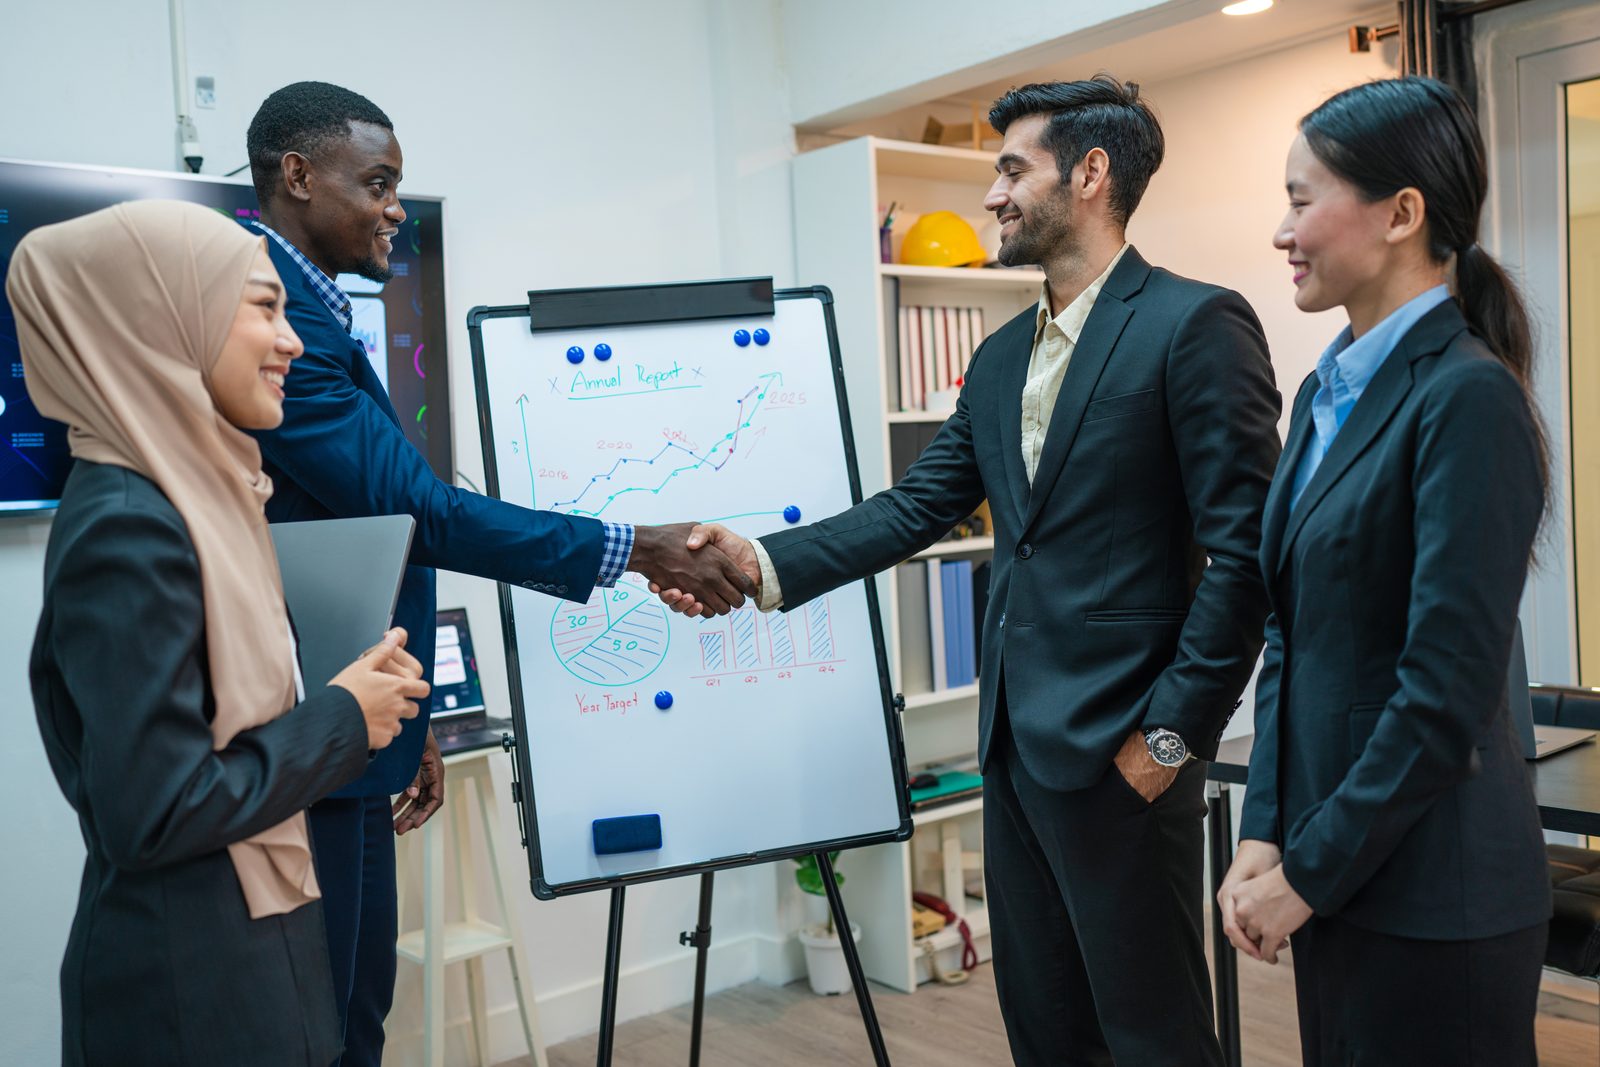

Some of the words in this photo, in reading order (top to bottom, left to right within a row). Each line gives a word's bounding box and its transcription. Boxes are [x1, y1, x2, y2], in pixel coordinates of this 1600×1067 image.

[570, 365, 621, 393] Annual
[634, 360, 683, 389] Report
[769, 392, 807, 405] 2025
[596, 440, 633, 450] 2020
[538, 468, 569, 481] 2018
[611, 590, 629, 602] 20
[567, 615, 588, 629] 30
[612, 640, 638, 651] 50
[706, 679, 721, 687] Q1
[744, 675, 758, 683] Q2
[777, 671, 792, 679] Q3
[818, 665, 836, 674] Q4
[575, 693, 600, 716] Year
[602, 691, 638, 715] Target
